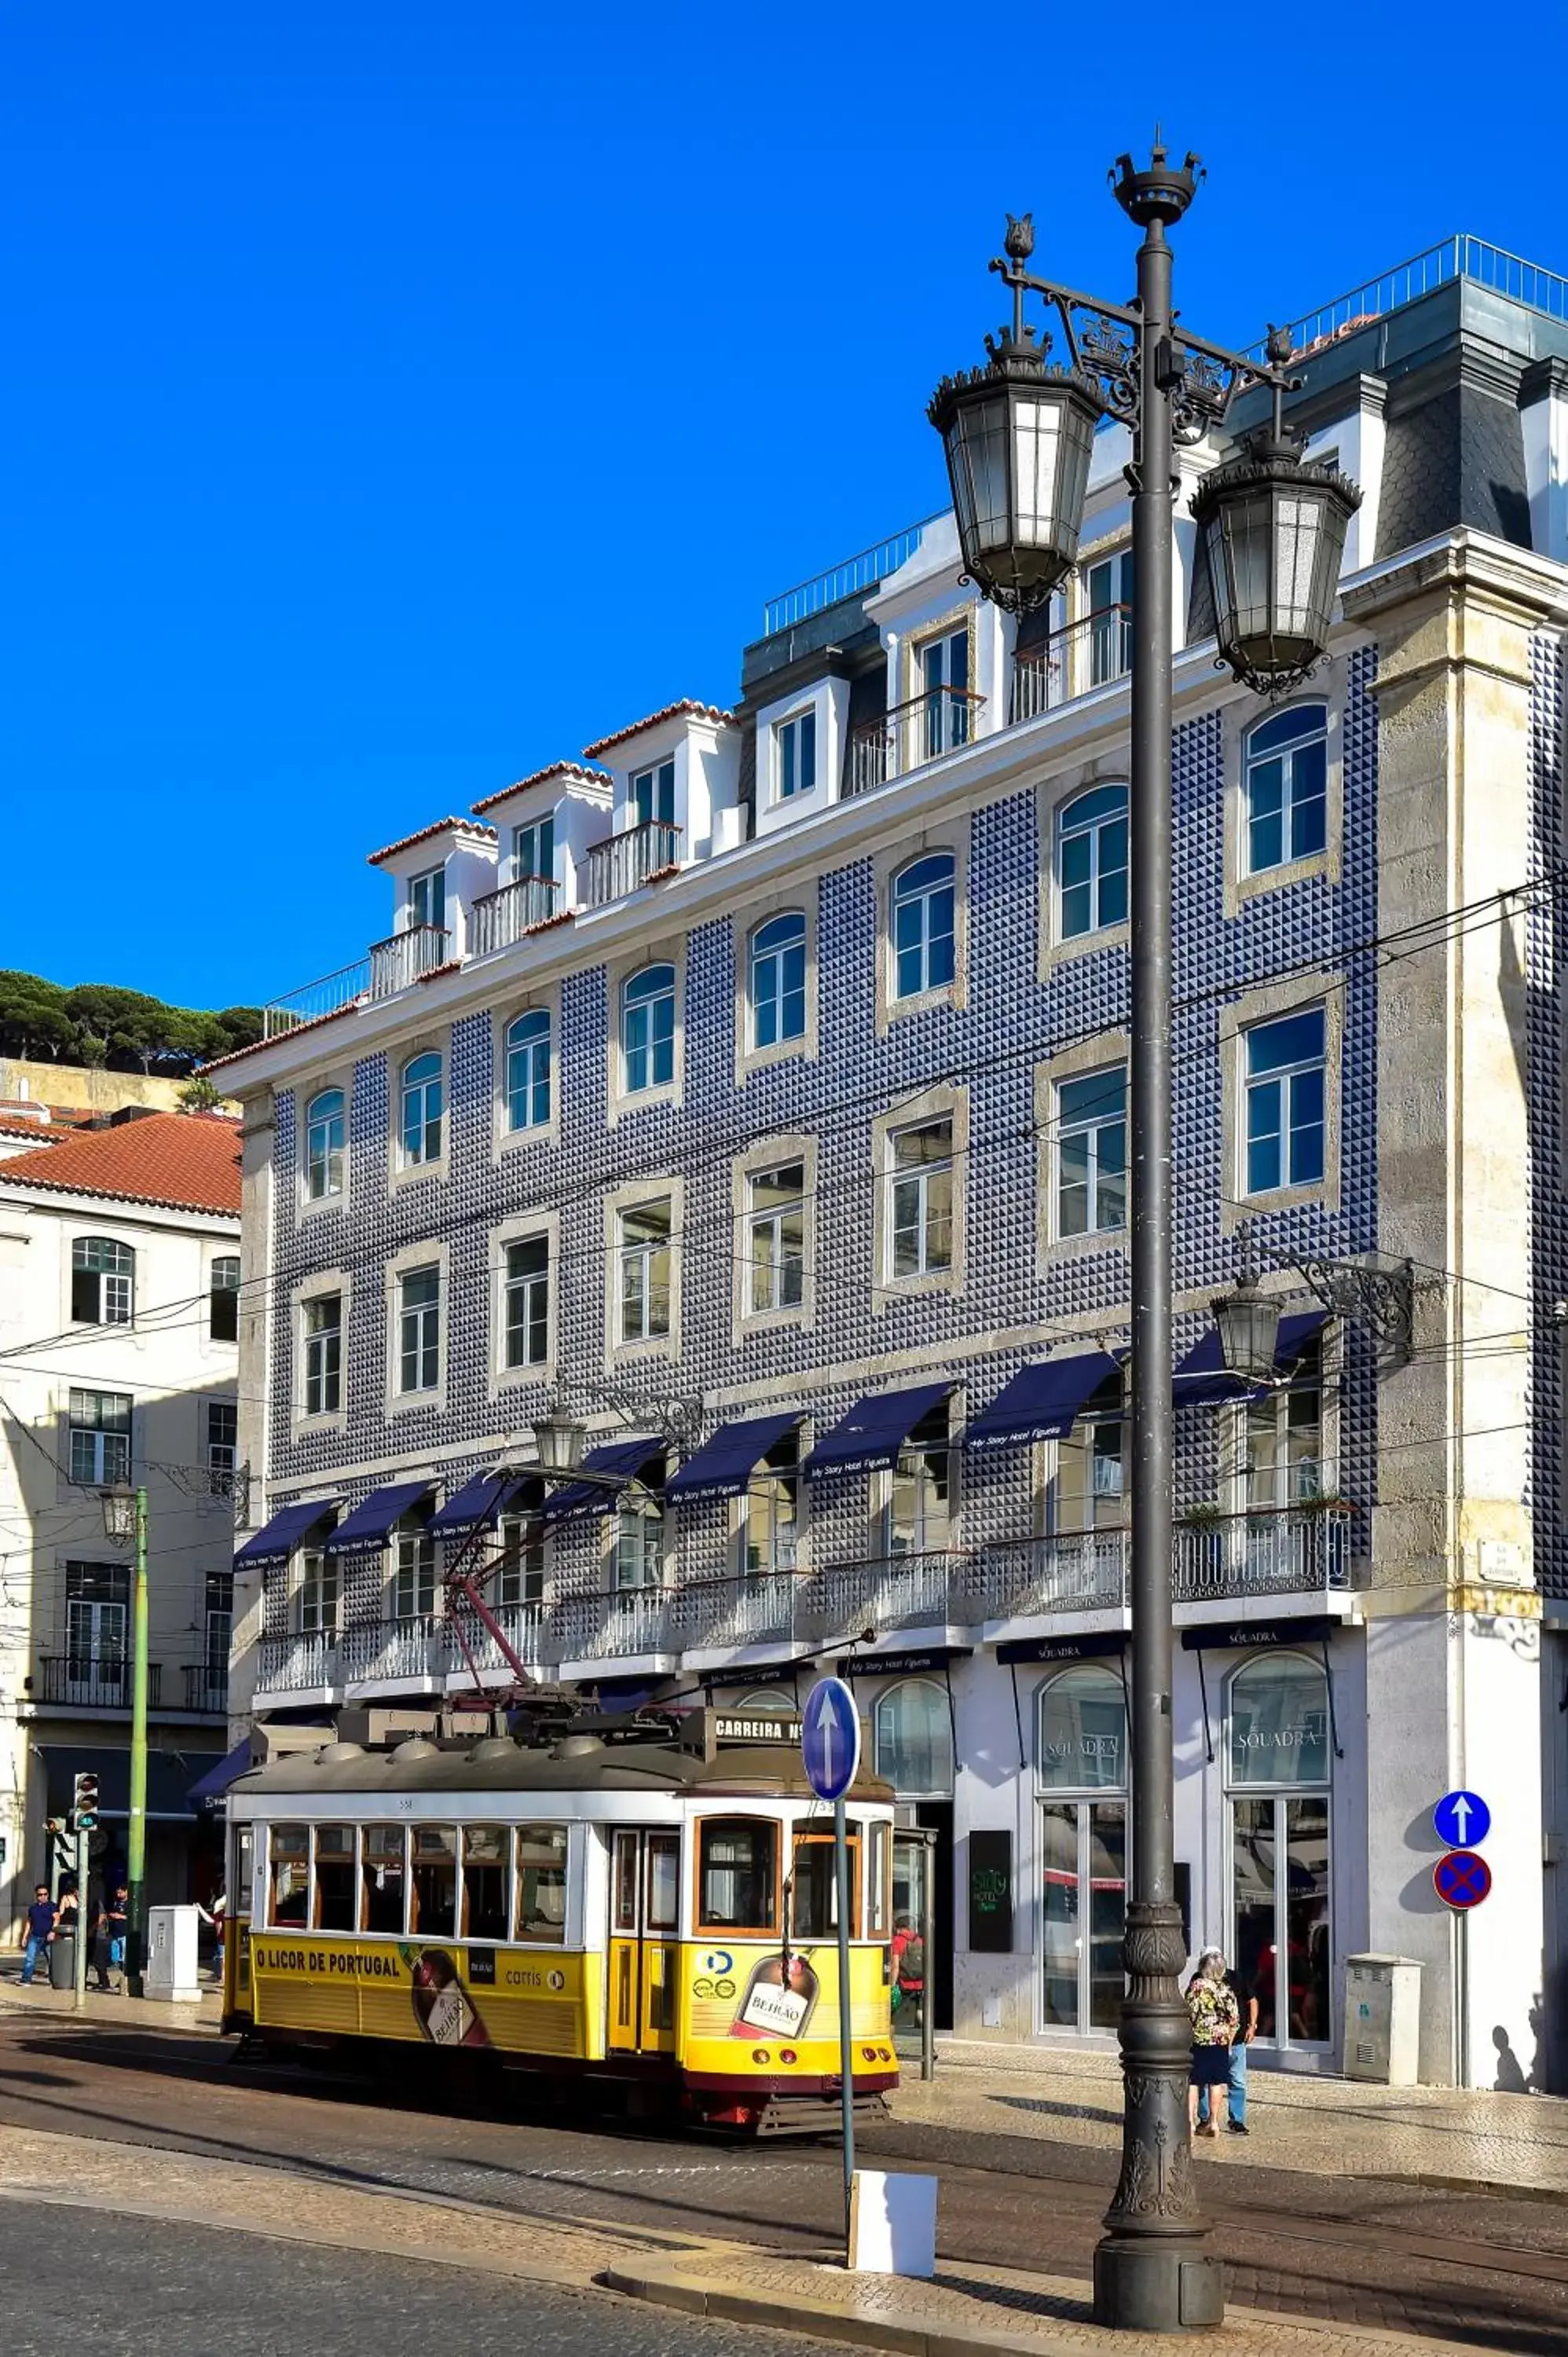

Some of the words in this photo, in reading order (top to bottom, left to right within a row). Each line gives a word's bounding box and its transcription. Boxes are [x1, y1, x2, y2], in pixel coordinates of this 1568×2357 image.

[986, 1436, 1009, 1446] Story
[824, 1464, 843, 1475] Story
[716, 1720, 782, 1739] CARREIRA
[256, 1948, 265, 1968] O
[268, 1949, 306, 1971] LICOR
[309, 1952, 326, 1972] DE
[329, 1953, 401, 1978] PORTUGAL
[505, 1966, 542, 1987] carris
